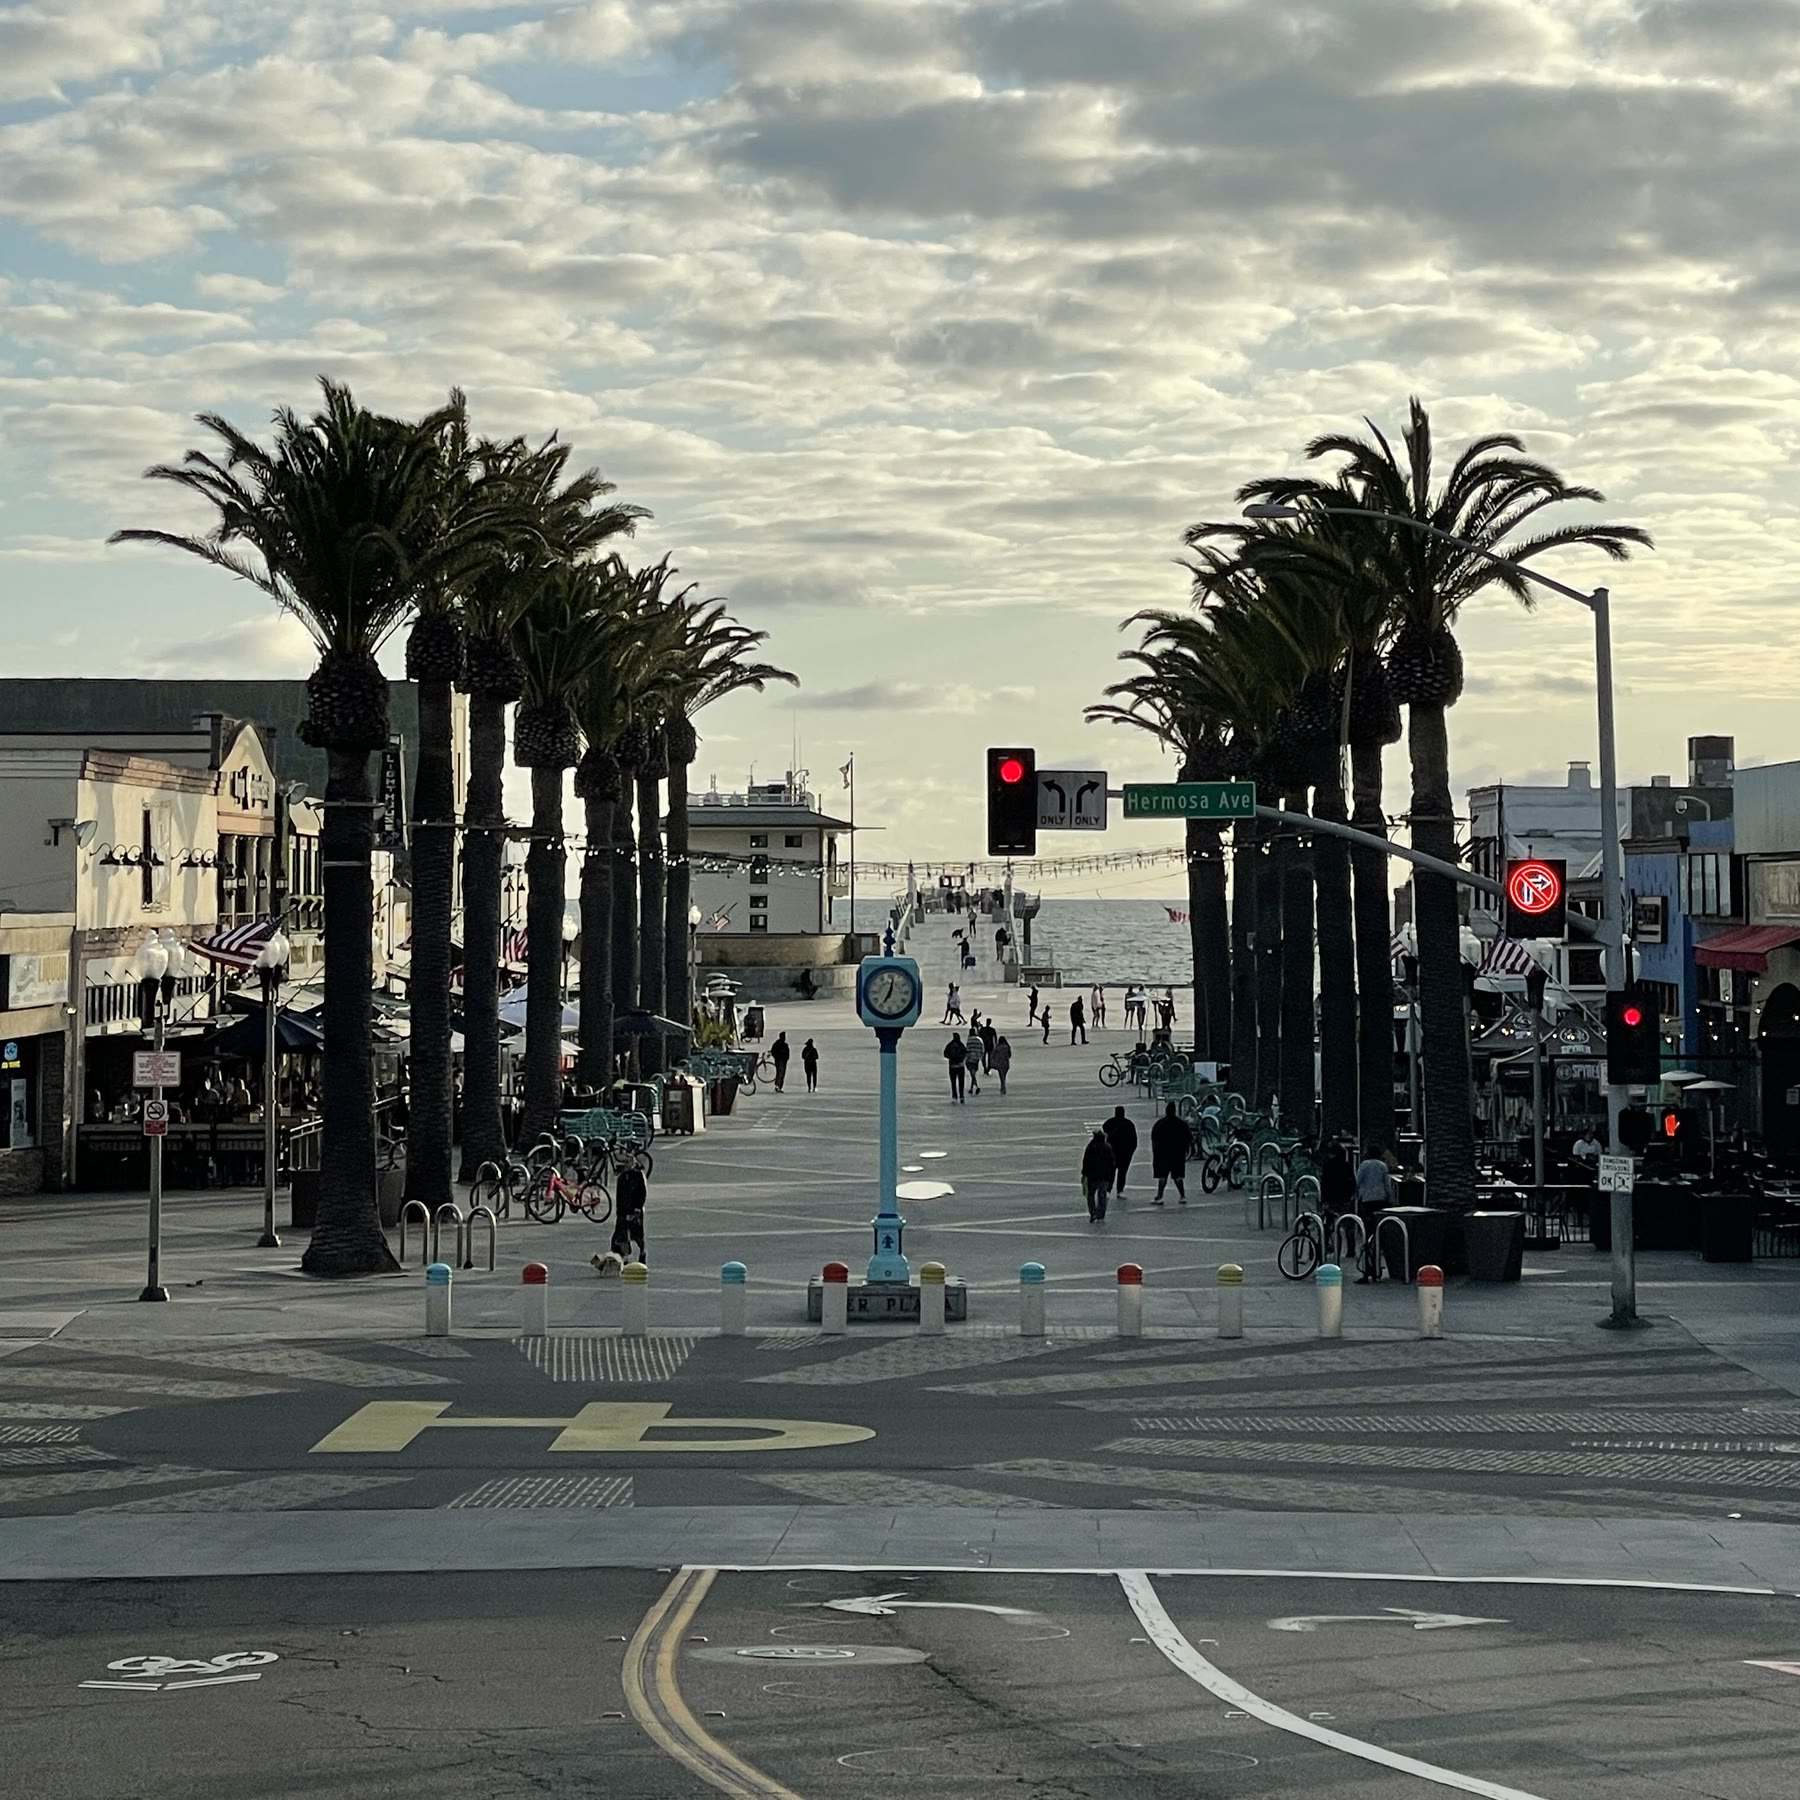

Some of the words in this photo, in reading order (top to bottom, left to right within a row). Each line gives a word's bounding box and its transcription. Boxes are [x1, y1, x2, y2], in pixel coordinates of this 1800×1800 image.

[1127, 792, 1209, 811] Hermosa
[1218, 791, 1250, 809] Ave
[1040, 815, 1065, 826] ONLY
[1074, 815, 1100, 826] ONLY
[1601, 1175, 1613, 1186] OK
[886, 1297, 954, 1312] PLAA
